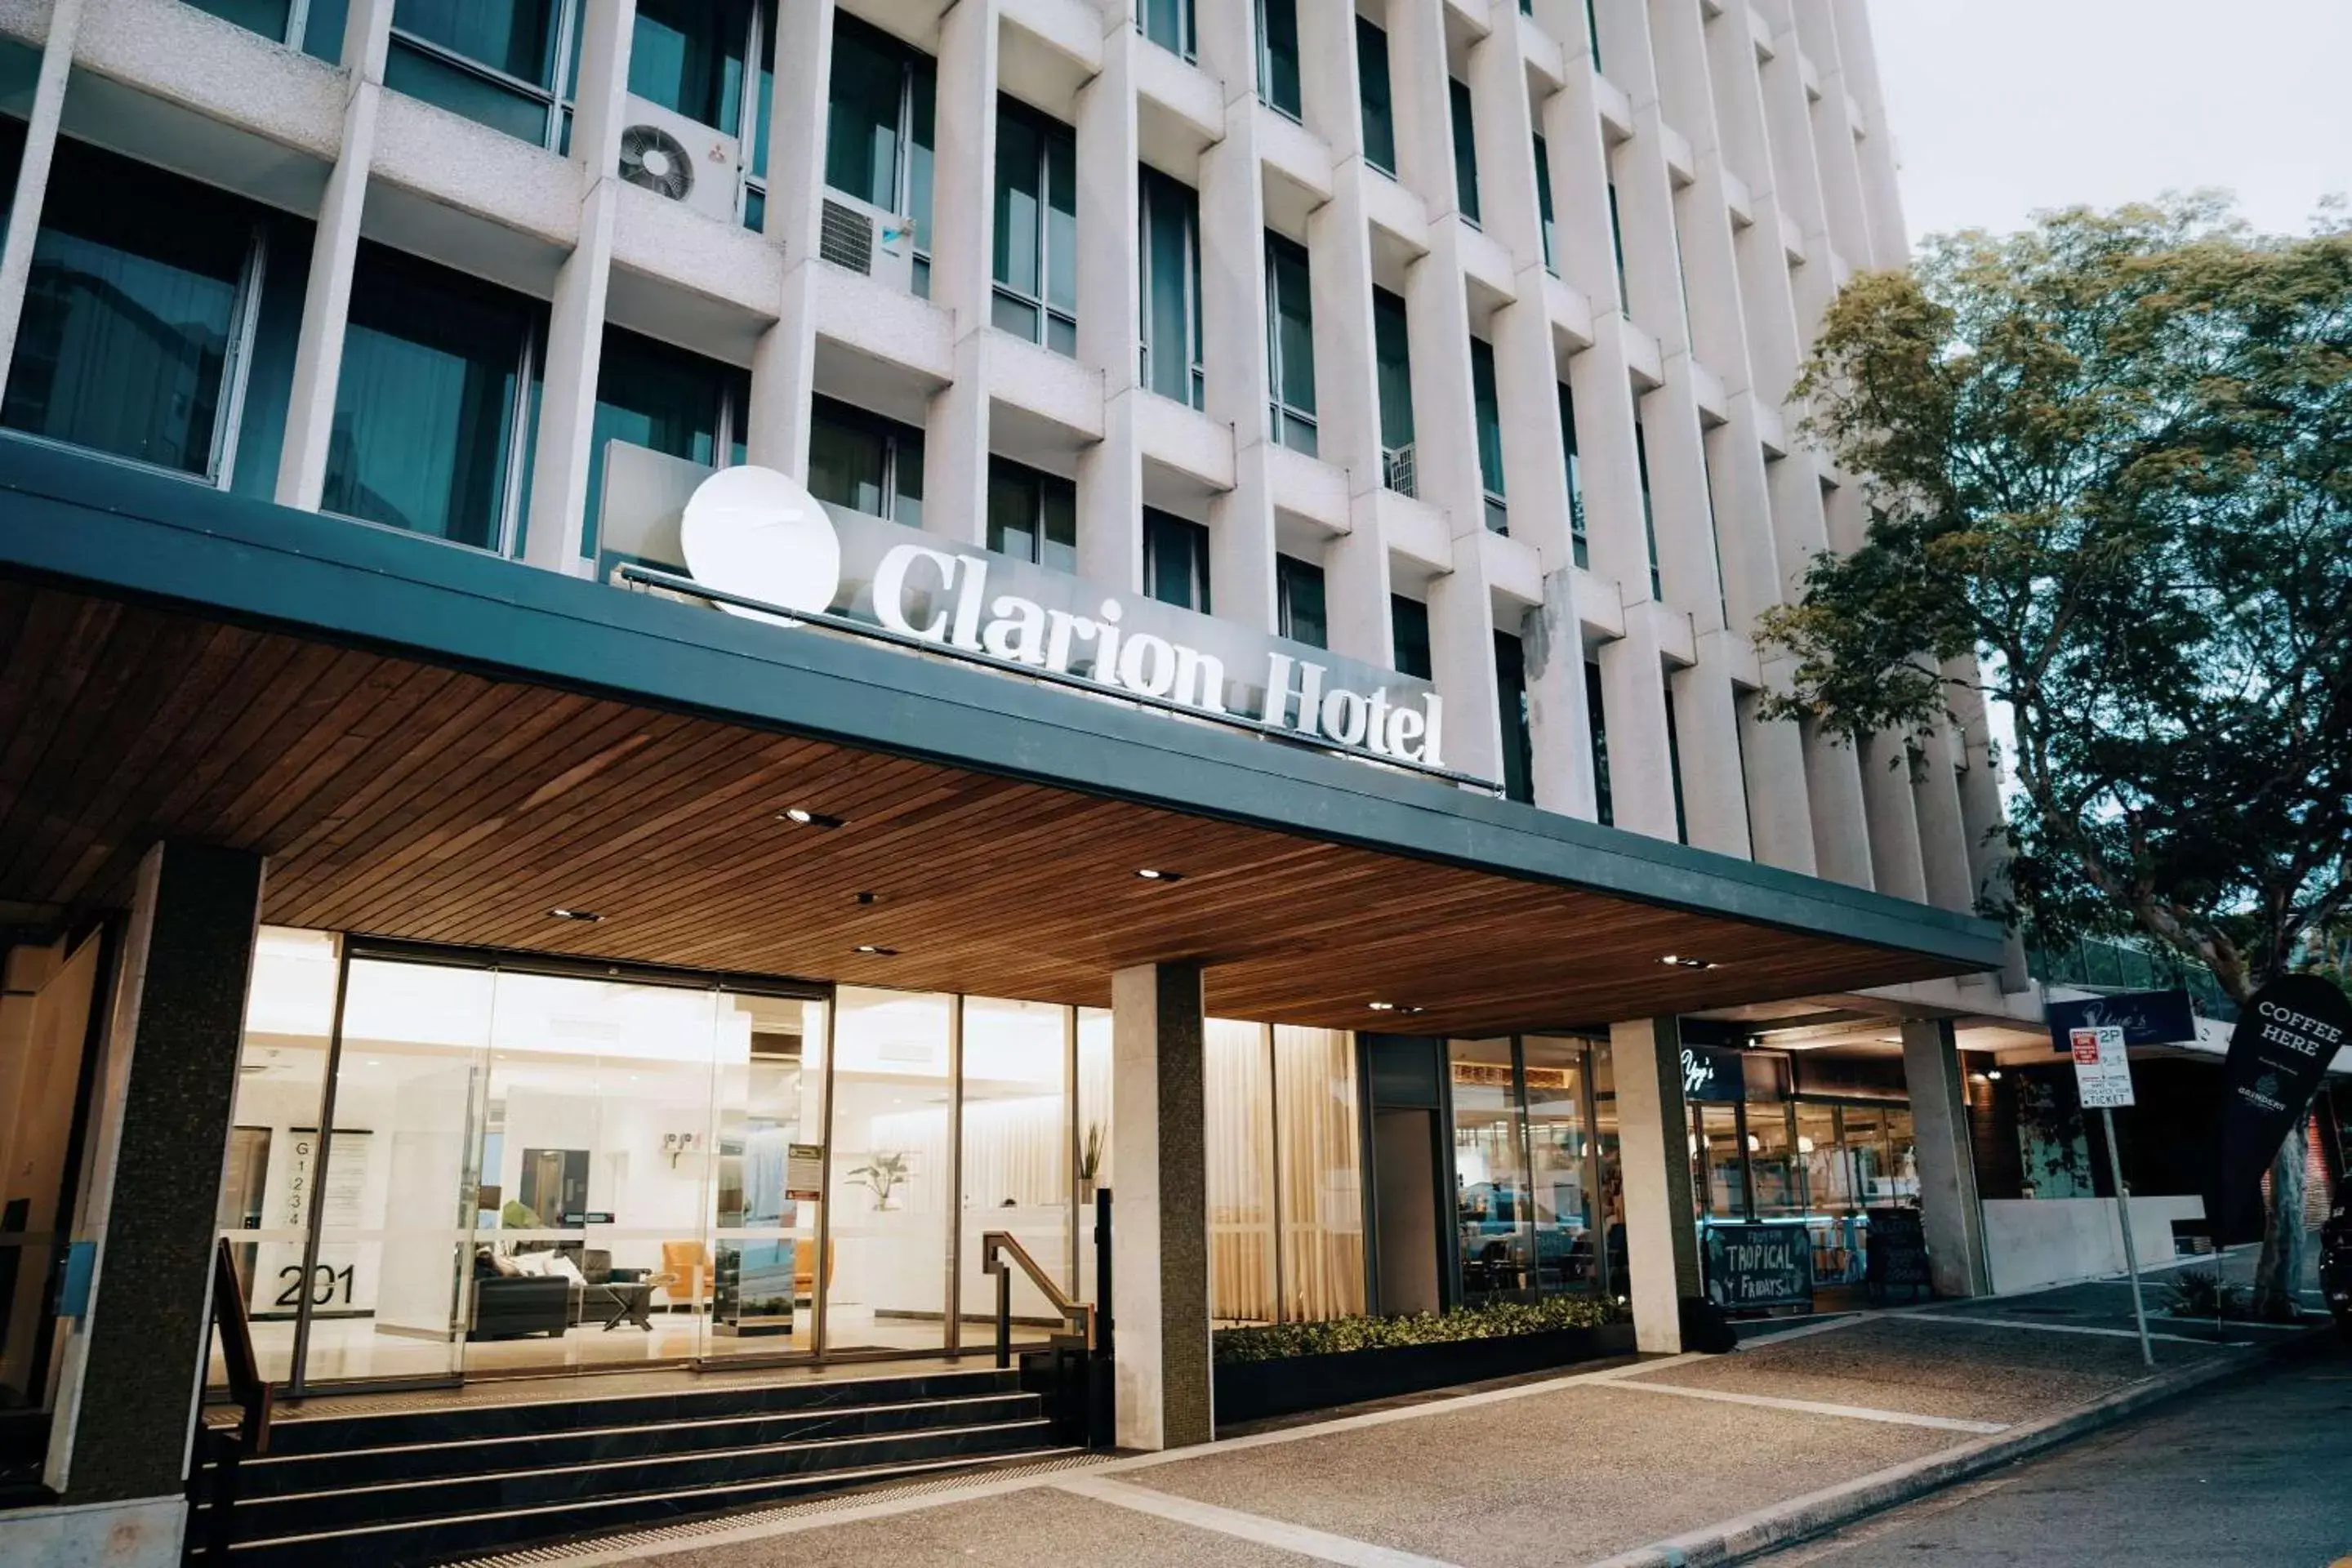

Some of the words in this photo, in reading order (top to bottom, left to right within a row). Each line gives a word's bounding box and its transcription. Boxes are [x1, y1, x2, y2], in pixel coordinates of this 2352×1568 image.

[872, 543, 1226, 714] Clarion
[1258, 651, 1445, 768] Hotel
[2258, 1000, 2344, 1044] COFFEE
[2100, 1029, 2121, 1043] 2P
[2261, 1022, 2320, 1057] HERE
[2089, 1094, 2125, 1105] TICKET
[296, 1142, 309, 1156] G
[298, 1160, 305, 1173] 1
[293, 1177, 304, 1191] 2
[291, 1195, 301, 1209] 3
[1724, 1242, 1794, 1272] TROPICAL
[274, 1263, 354, 1307] 201
[1740, 1274, 1784, 1298] FRIDAYS
